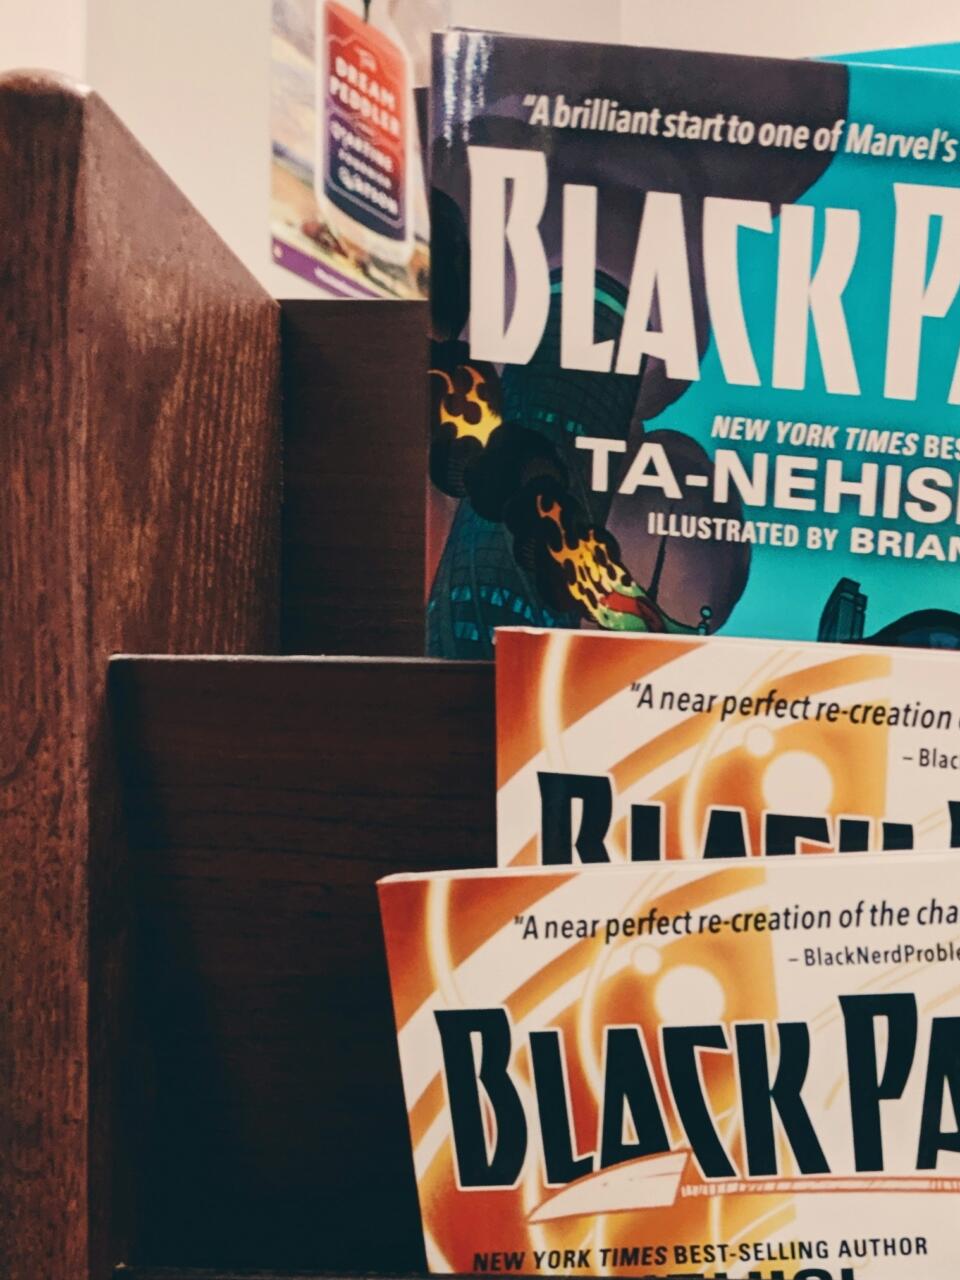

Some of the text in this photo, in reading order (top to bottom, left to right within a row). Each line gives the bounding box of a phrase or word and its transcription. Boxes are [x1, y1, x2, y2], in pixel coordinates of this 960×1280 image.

[553, 95, 660, 136] brilliant
[662, 110, 725, 142] start
[728, 115, 754, 145] to
[758, 122, 809, 150] one
[813, 119, 845, 152] of
[845, 123, 957, 163] Marvel's
[467, 145, 861, 396] BLACK
[711, 415, 770, 442] NEW
[776, 421, 838, 448] YORK
[845, 427, 919, 456] TIMES
[648, 512, 799, 545] ILLUSTRATED
[806, 525, 838, 551] BY
[660, 690, 717, 714] near
[721, 688, 811, 722] perfect
[815, 700, 951, 732] re-creation
[544, 917, 599, 939] near
[604, 907, 693, 944] perfect
[698, 904, 832, 935] re-creation
[838, 900, 868, 931] of
[868, 900, 910, 929] the
[433, 1007, 833, 1187] BLACK
[473, 1237, 928, 1273] NEW YORK TIMES BEST-SELLING AUTHOR
